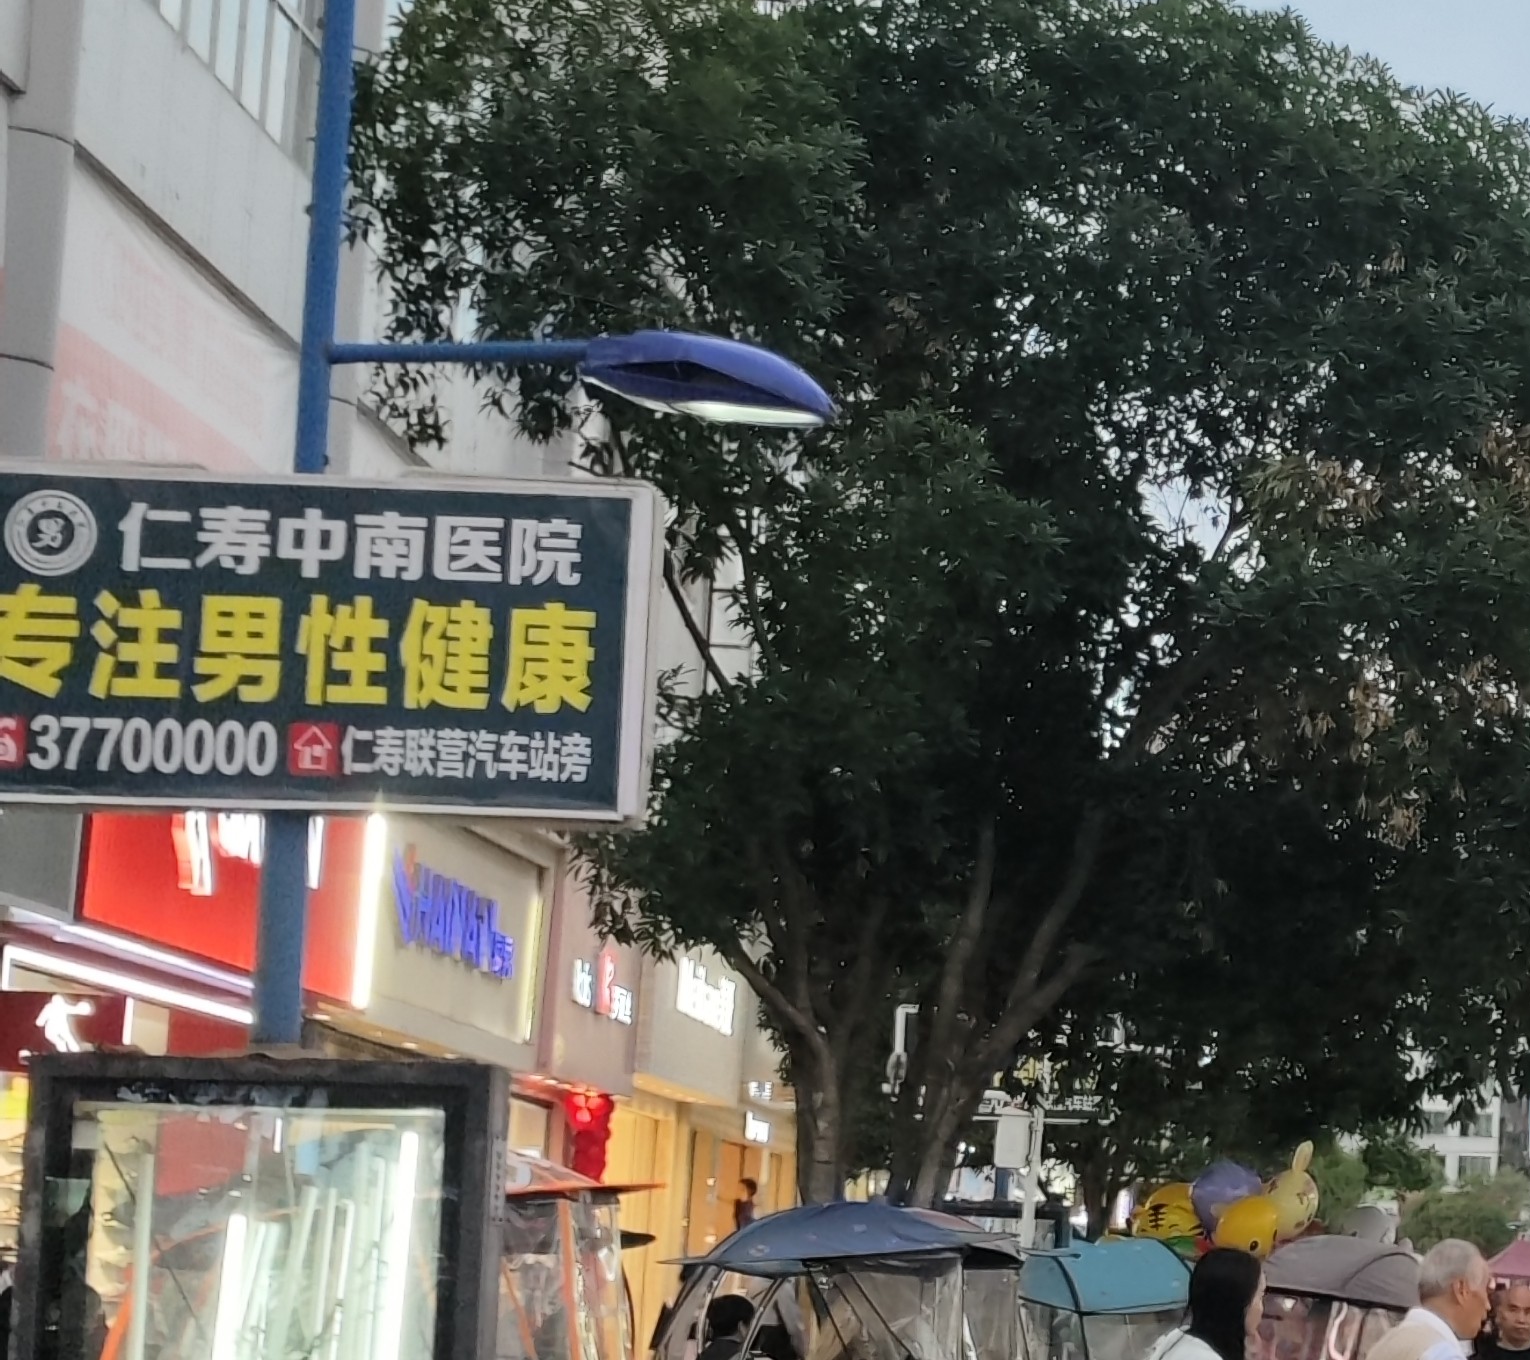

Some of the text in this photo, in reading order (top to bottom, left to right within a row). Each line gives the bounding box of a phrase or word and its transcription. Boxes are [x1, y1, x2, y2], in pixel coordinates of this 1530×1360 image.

[118, 502, 583, 587] 仁寿中南医院
[0, 584, 596, 714] 专注男性健康
[27, 715, 593, 784] 37700000 仁寿联营汽车站旁
